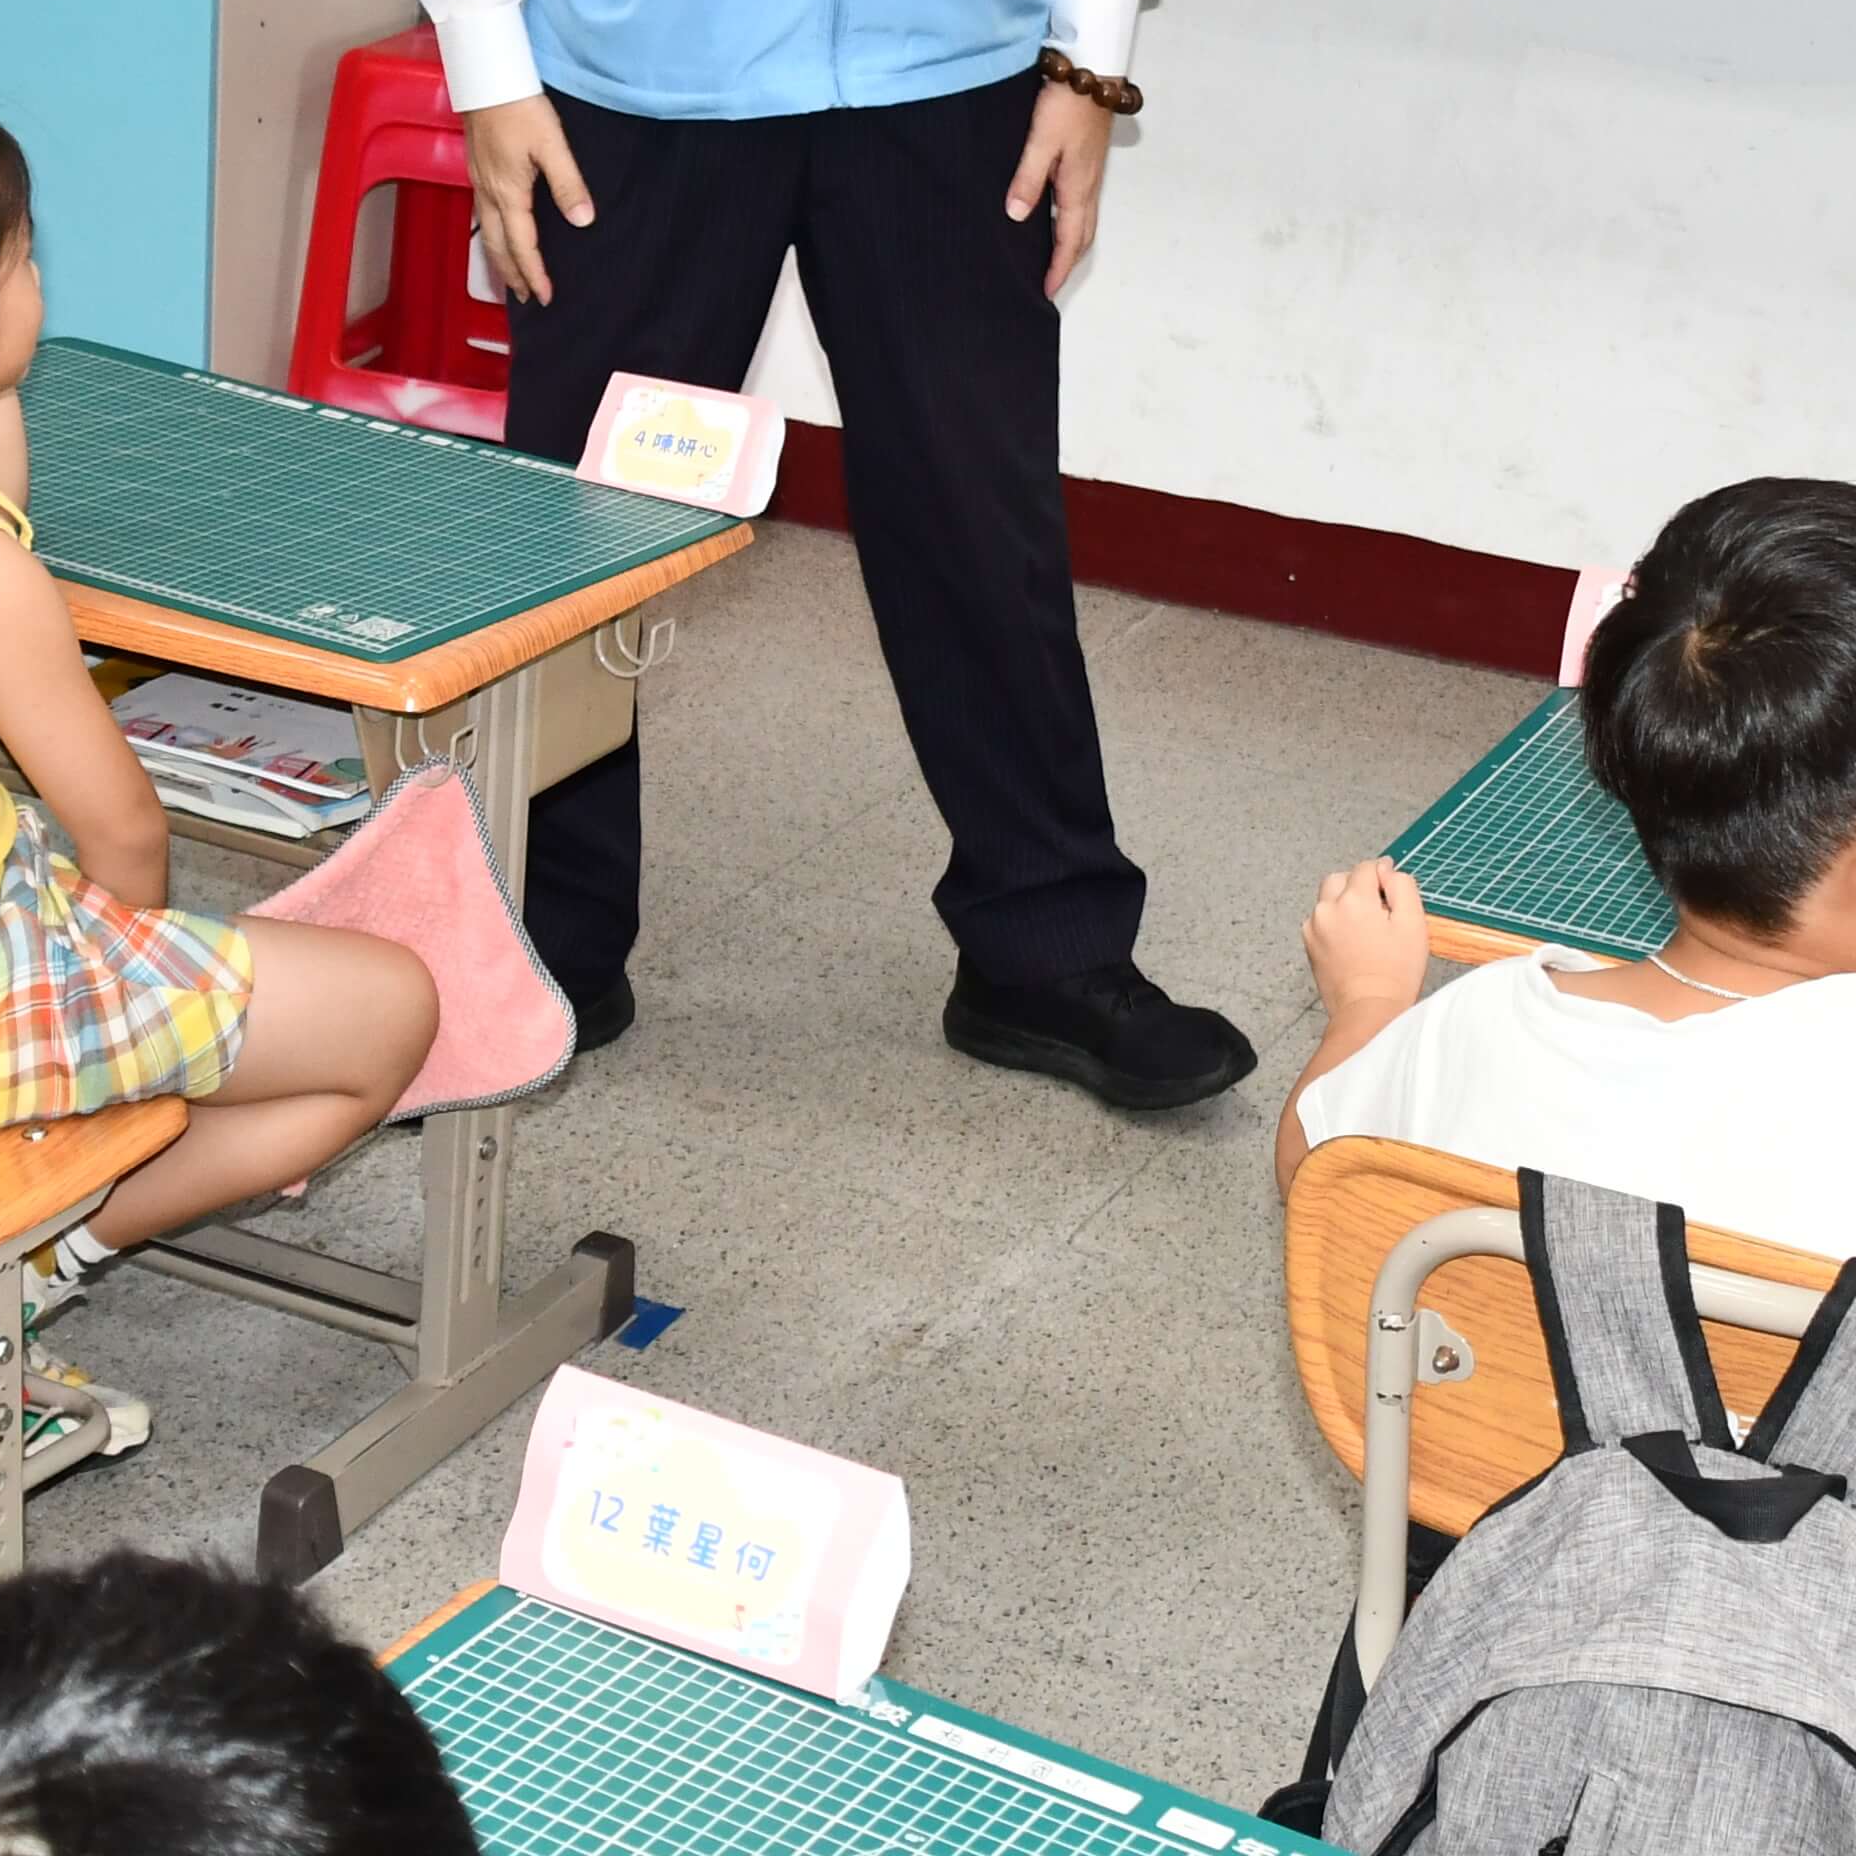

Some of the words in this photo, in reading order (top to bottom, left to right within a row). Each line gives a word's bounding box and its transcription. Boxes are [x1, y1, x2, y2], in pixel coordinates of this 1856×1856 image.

[590, 1489, 625, 1533] 12
[642, 1503, 776, 1581] 葉星何
